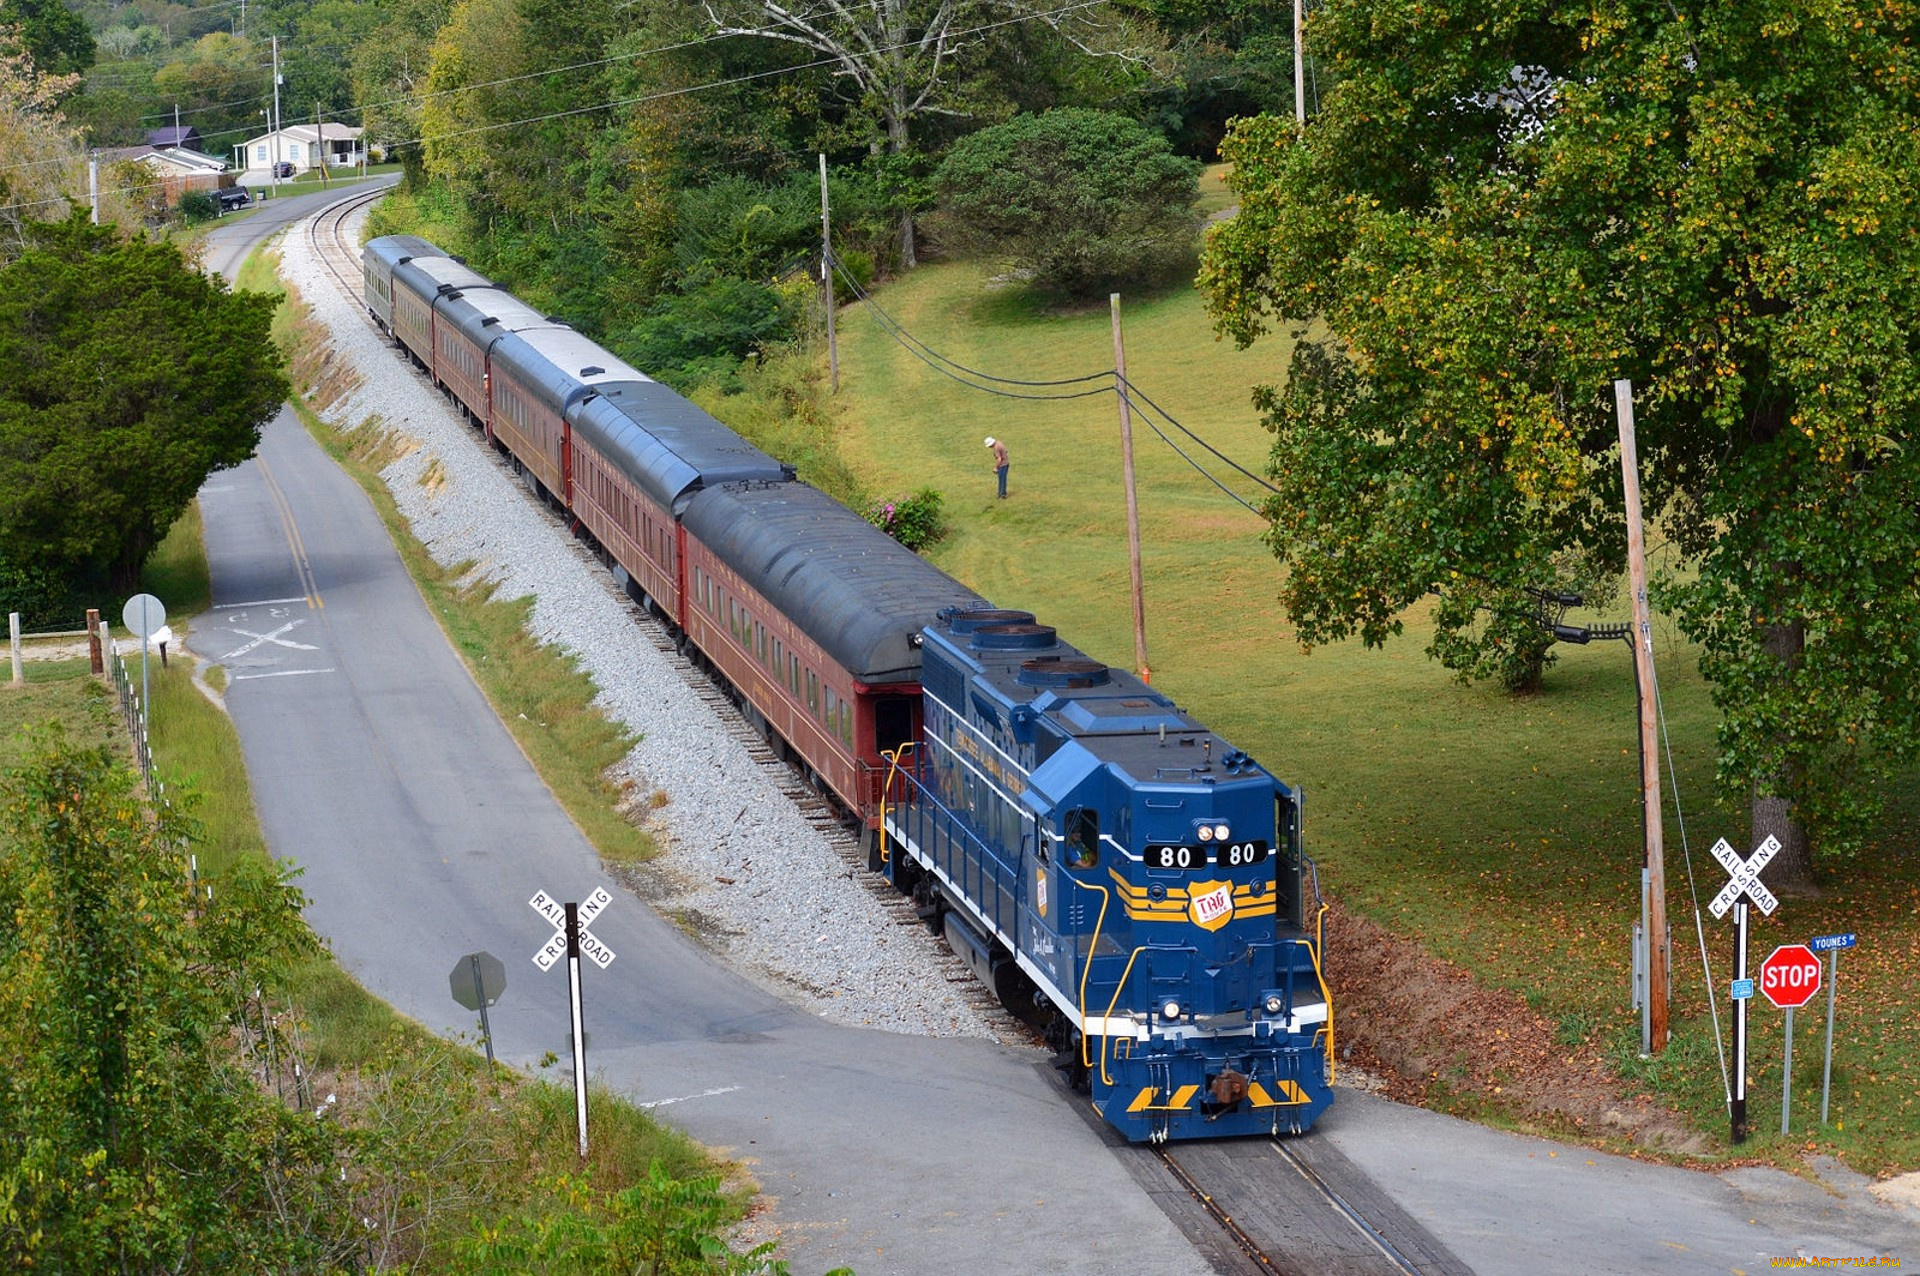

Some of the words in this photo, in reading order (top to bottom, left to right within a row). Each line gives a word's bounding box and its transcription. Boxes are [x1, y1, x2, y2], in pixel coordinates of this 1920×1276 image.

[1160, 847, 1191, 868] 80
[1229, 843, 1255, 866] 80
[1196, 891, 1225, 914] TAG
[537, 891, 608, 967] CROING
[1765, 964, 1817, 989] STOP
